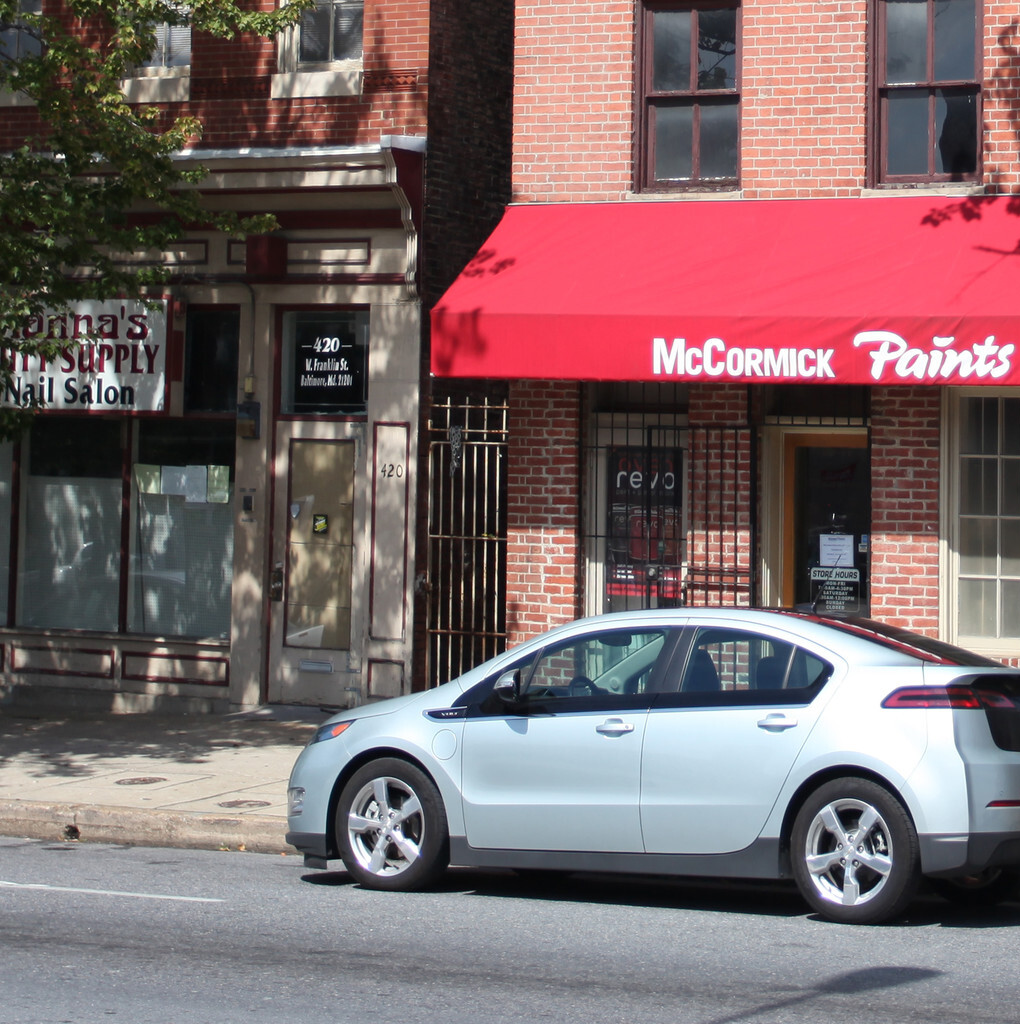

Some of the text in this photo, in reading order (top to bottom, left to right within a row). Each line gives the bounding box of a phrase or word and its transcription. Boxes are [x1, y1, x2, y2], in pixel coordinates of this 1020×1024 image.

[313, 336, 340, 353] 420
[61, 343, 160, 374] SUPPLY
[853, 329, 1016, 380] Paints
[314, 358, 339, 371] Franklin
[340, 358, 349, 371] St.
[4, 375, 135, 406] Nail Salon
[380, 463, 404, 478] 420
[812, 570, 858, 580] STORE HOURS
